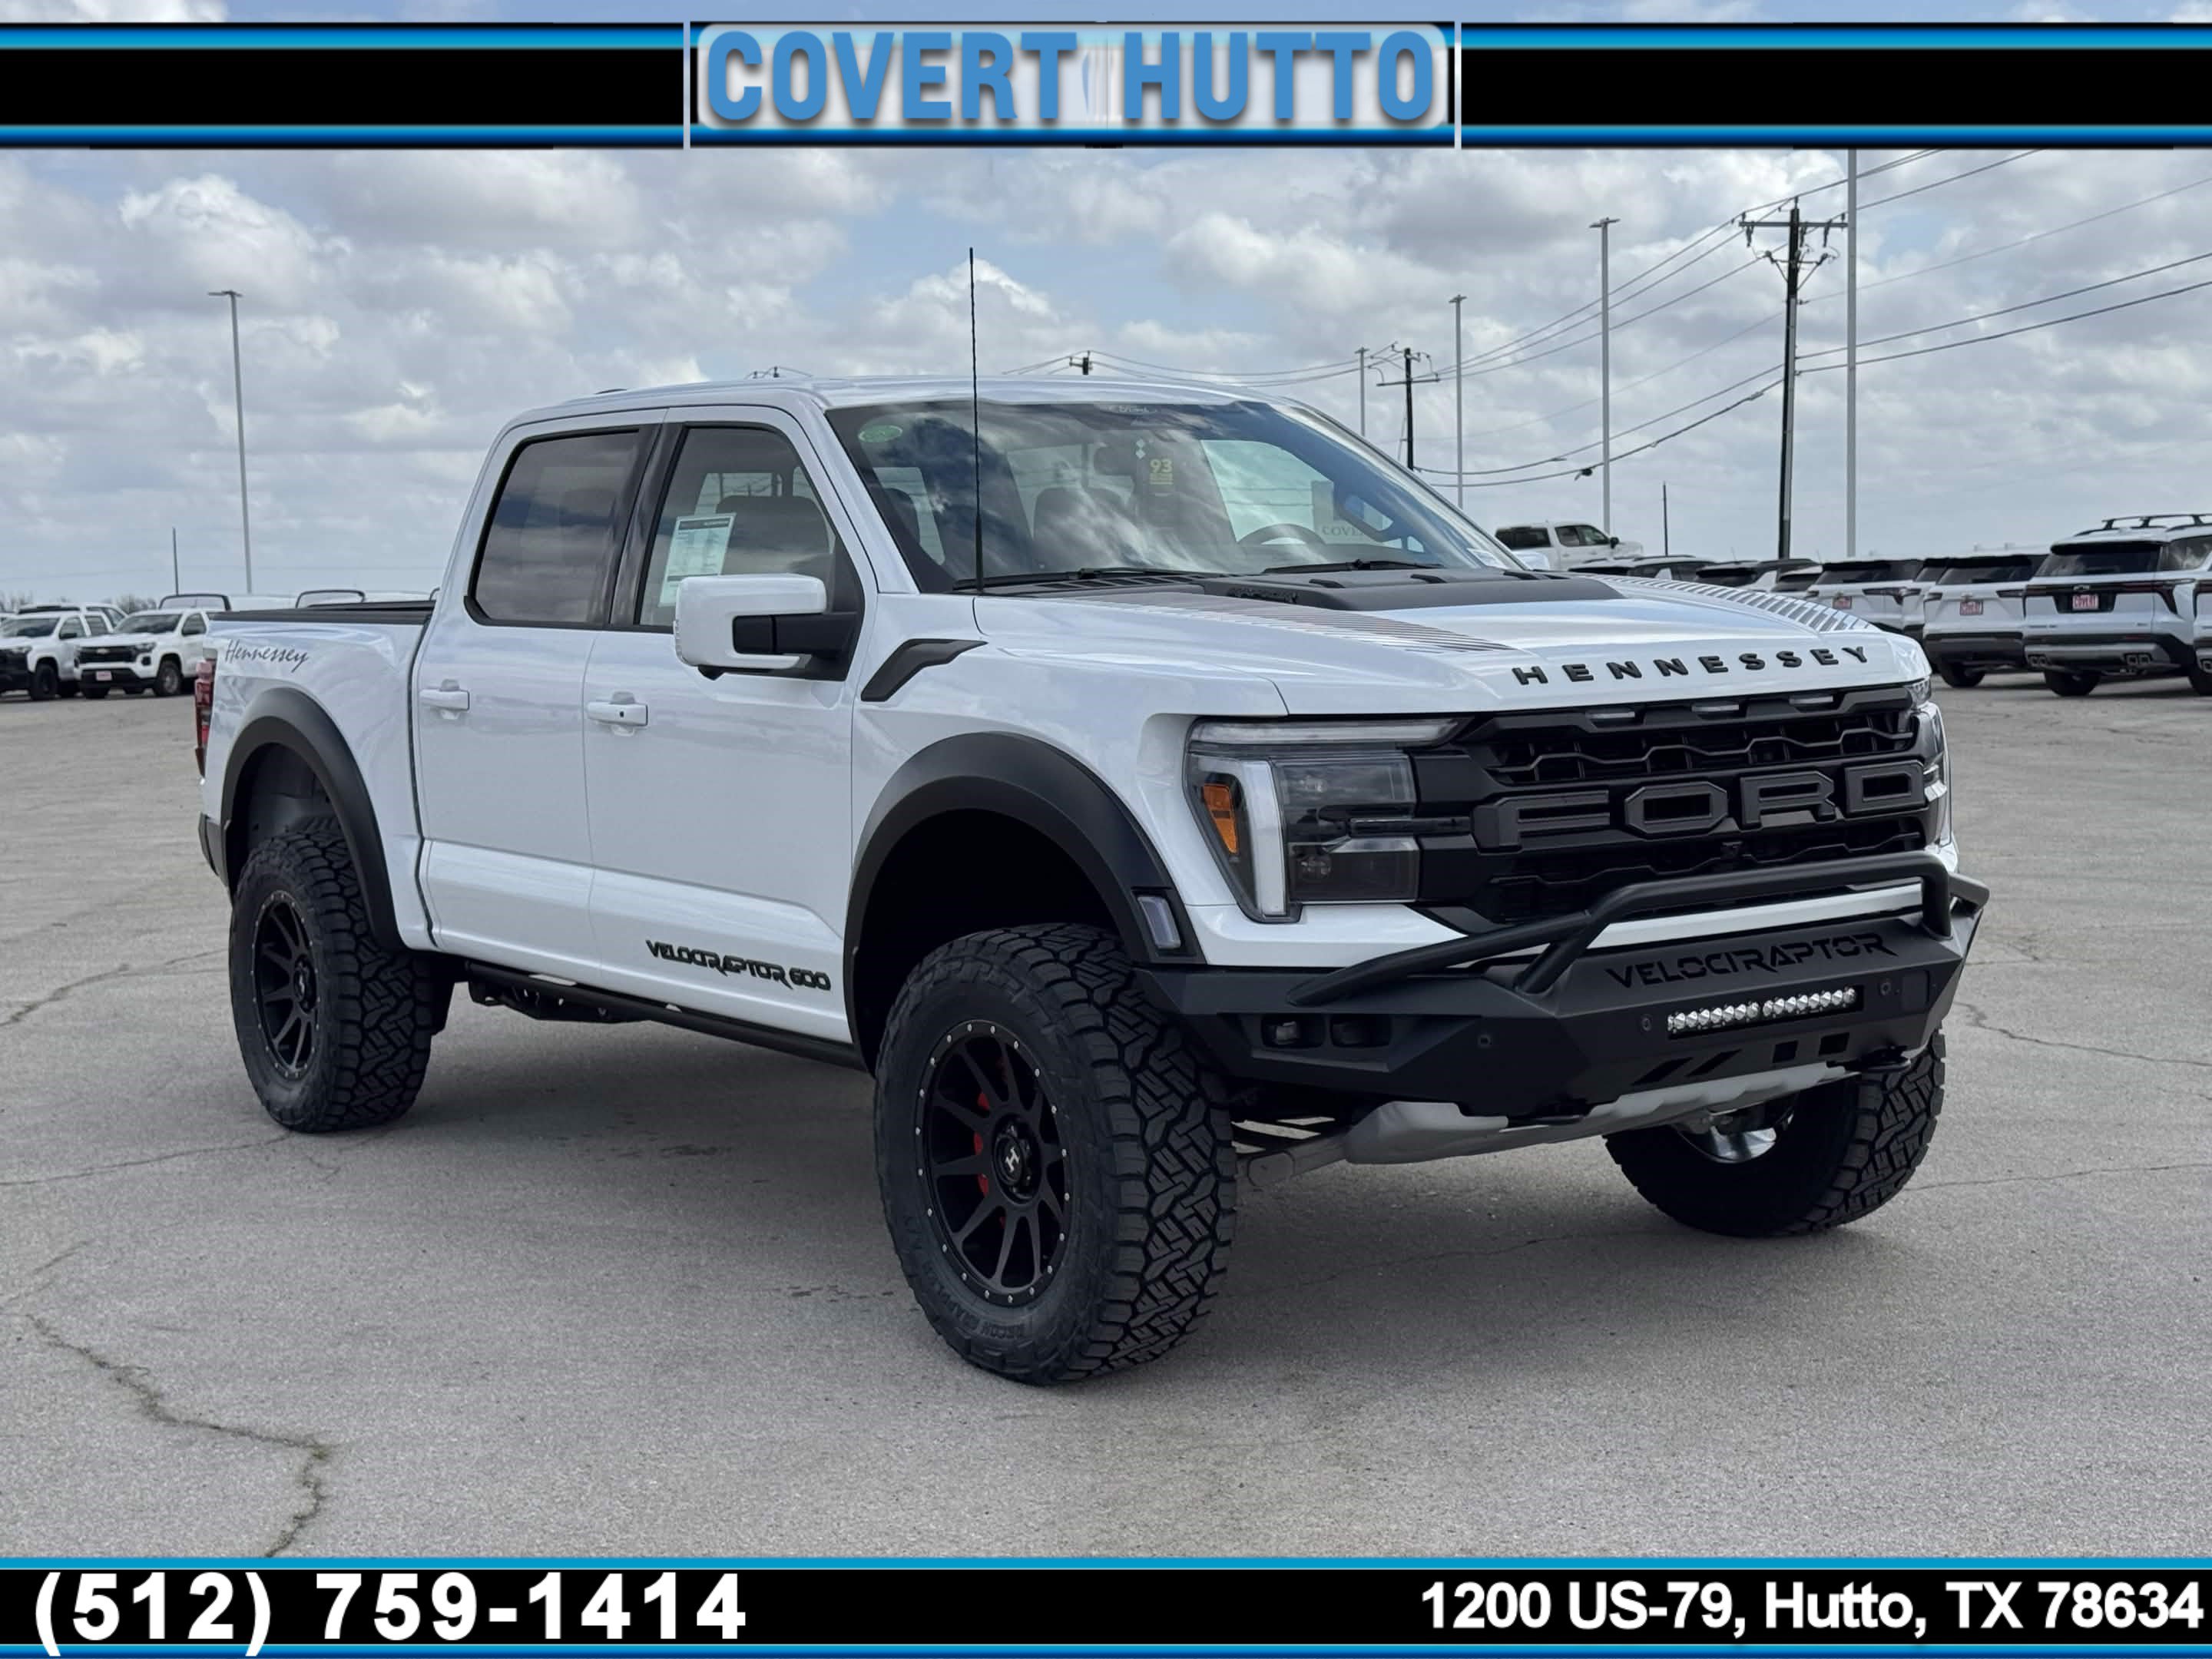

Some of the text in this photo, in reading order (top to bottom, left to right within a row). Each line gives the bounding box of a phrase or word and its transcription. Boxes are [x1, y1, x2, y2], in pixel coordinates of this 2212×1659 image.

[1150, 458, 1173, 474] 93
[224, 638, 309, 674] Hennessey
[1512, 645, 1868, 685] HENNESSEY
[1482, 760, 1925, 850] FORD
[645, 939, 832, 992] VELOCIRAPTOR 600
[1604, 932, 1899, 989] VELOCIRAPTOR
